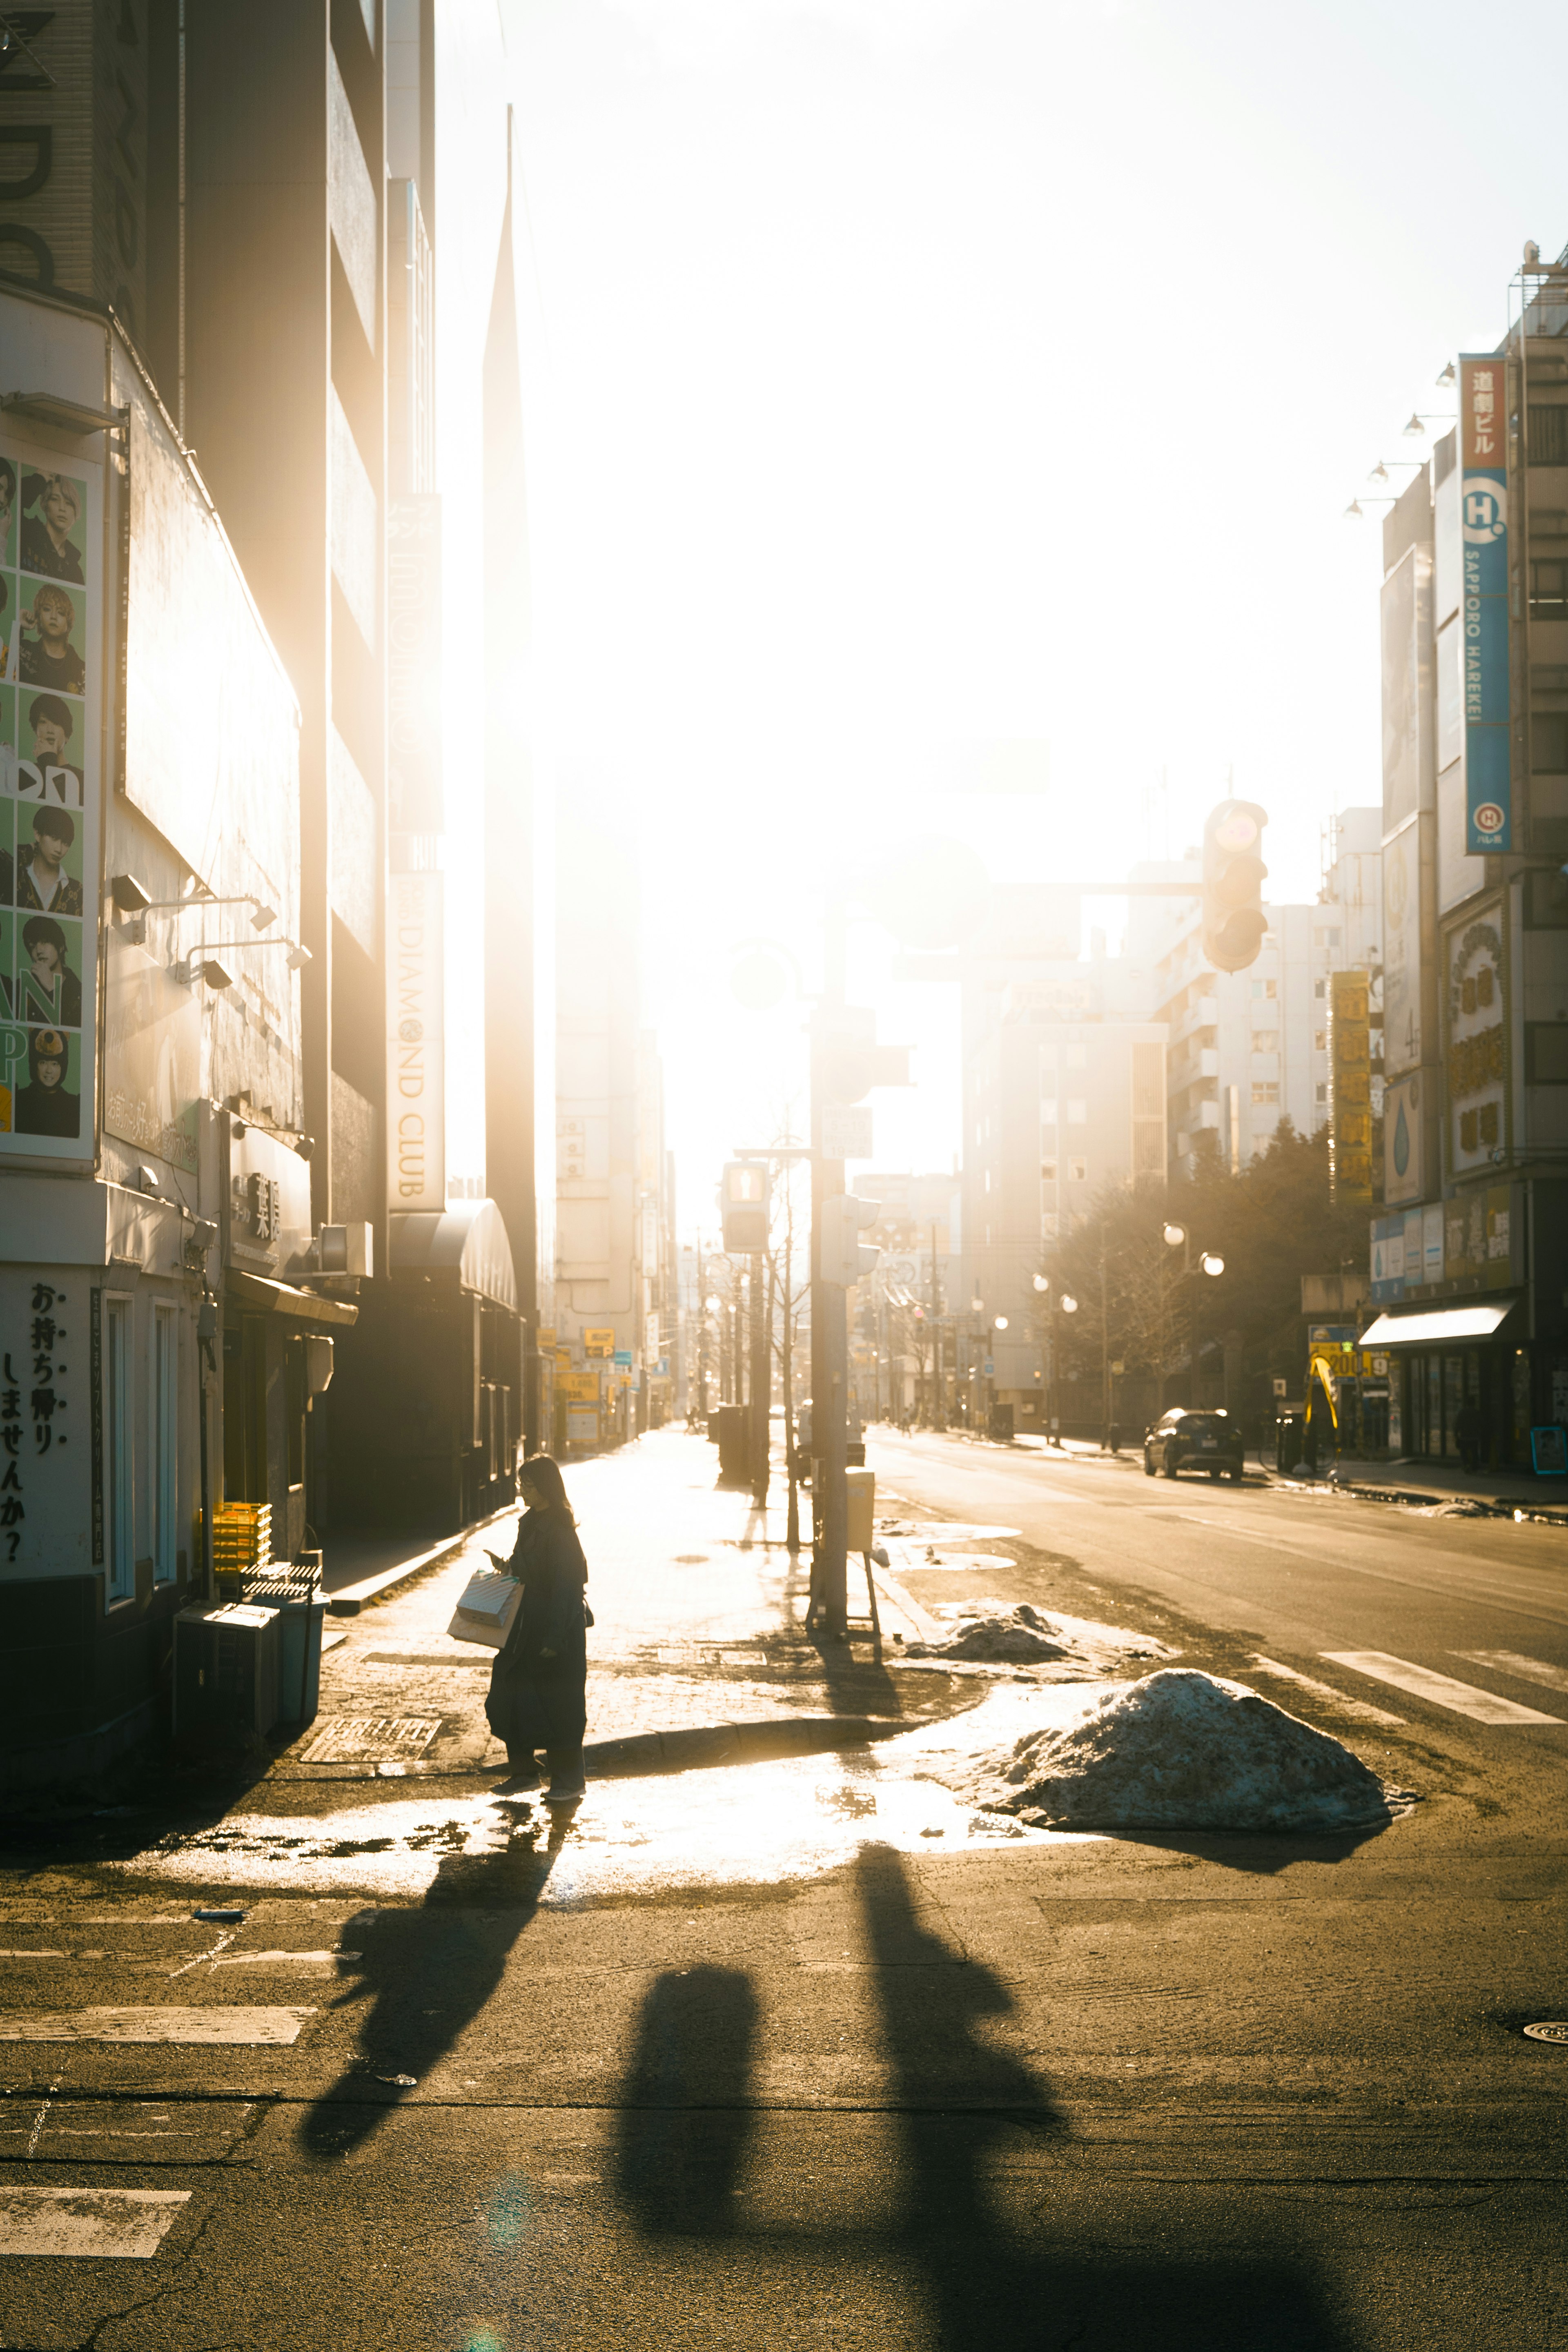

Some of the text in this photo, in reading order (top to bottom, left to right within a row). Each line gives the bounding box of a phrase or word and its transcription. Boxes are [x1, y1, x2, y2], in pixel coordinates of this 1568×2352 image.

[1473, 371, 1495, 454] 道劇ビル
[1466, 550, 1482, 722] SAPPORO HAREKEI
[397, 925, 424, 1198] DIAMOND CLUB
[31, 1283, 57, 1454] お持ち帰り
[603, 1346, 613, 1358] P
